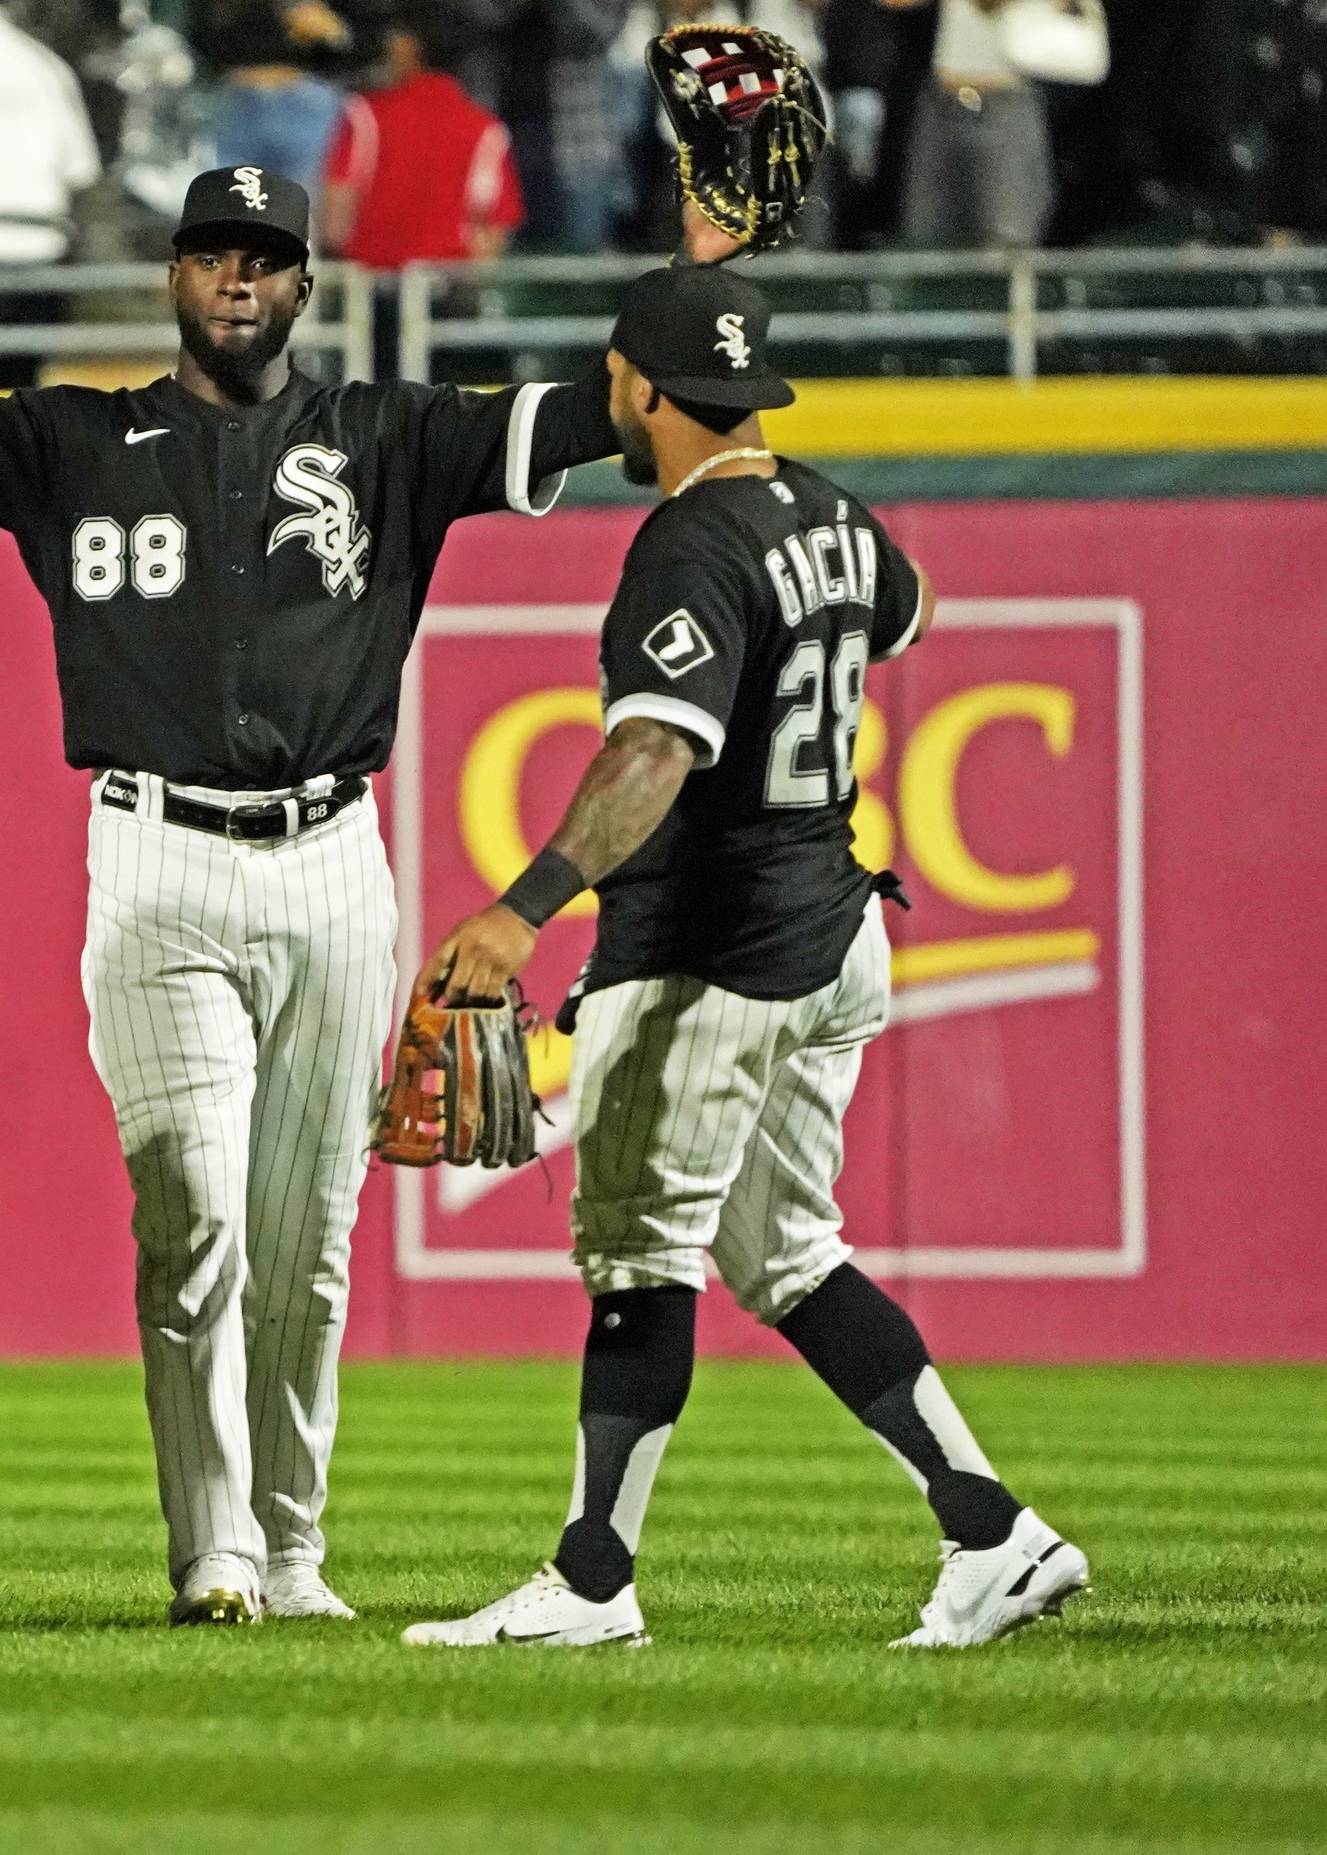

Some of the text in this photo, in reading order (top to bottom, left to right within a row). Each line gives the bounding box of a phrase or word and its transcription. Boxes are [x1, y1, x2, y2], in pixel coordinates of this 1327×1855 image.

[73, 513, 187, 601] 88
[266, 443, 371, 600] Sox
[763, 630, 870, 809] 28
[306, 803, 328, 822] 88
